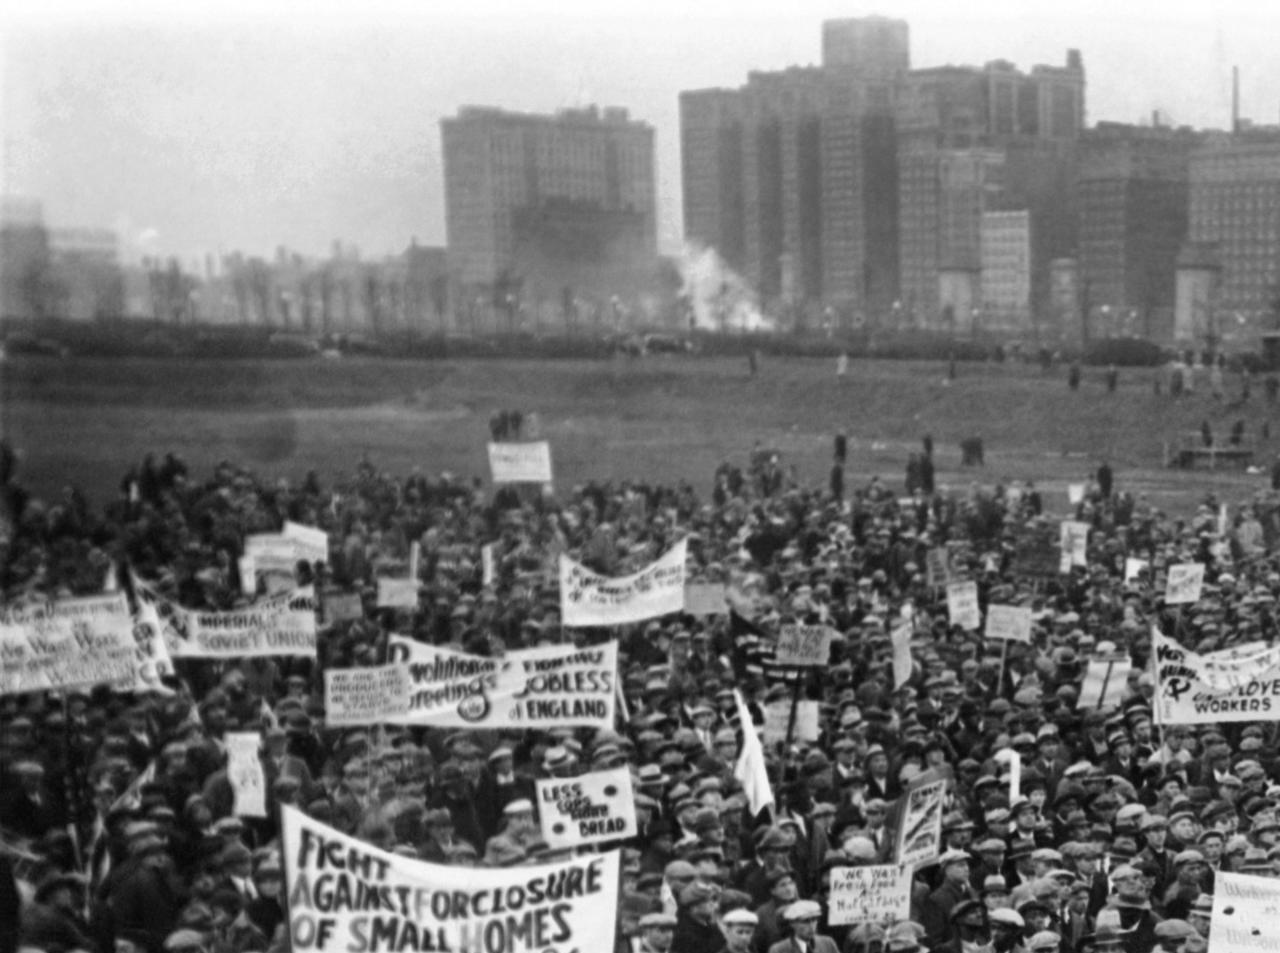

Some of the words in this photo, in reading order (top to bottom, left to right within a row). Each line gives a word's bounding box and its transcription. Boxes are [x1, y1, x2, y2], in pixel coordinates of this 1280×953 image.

[512, 670, 612, 699] JOBLESS
[526, 700, 607, 719] ENGLAND
[1195, 698, 1271, 714] WORKERS
[542, 782, 583, 802] LESS
[579, 816, 626, 837] BREAD
[297, 825, 390, 880] FIGHT
[289, 870, 412, 917] AGAINST
[413, 857, 605, 921] FORCLOSURE
[291, 911, 337, 951] OF
[347, 914, 454, 953] SMALL
